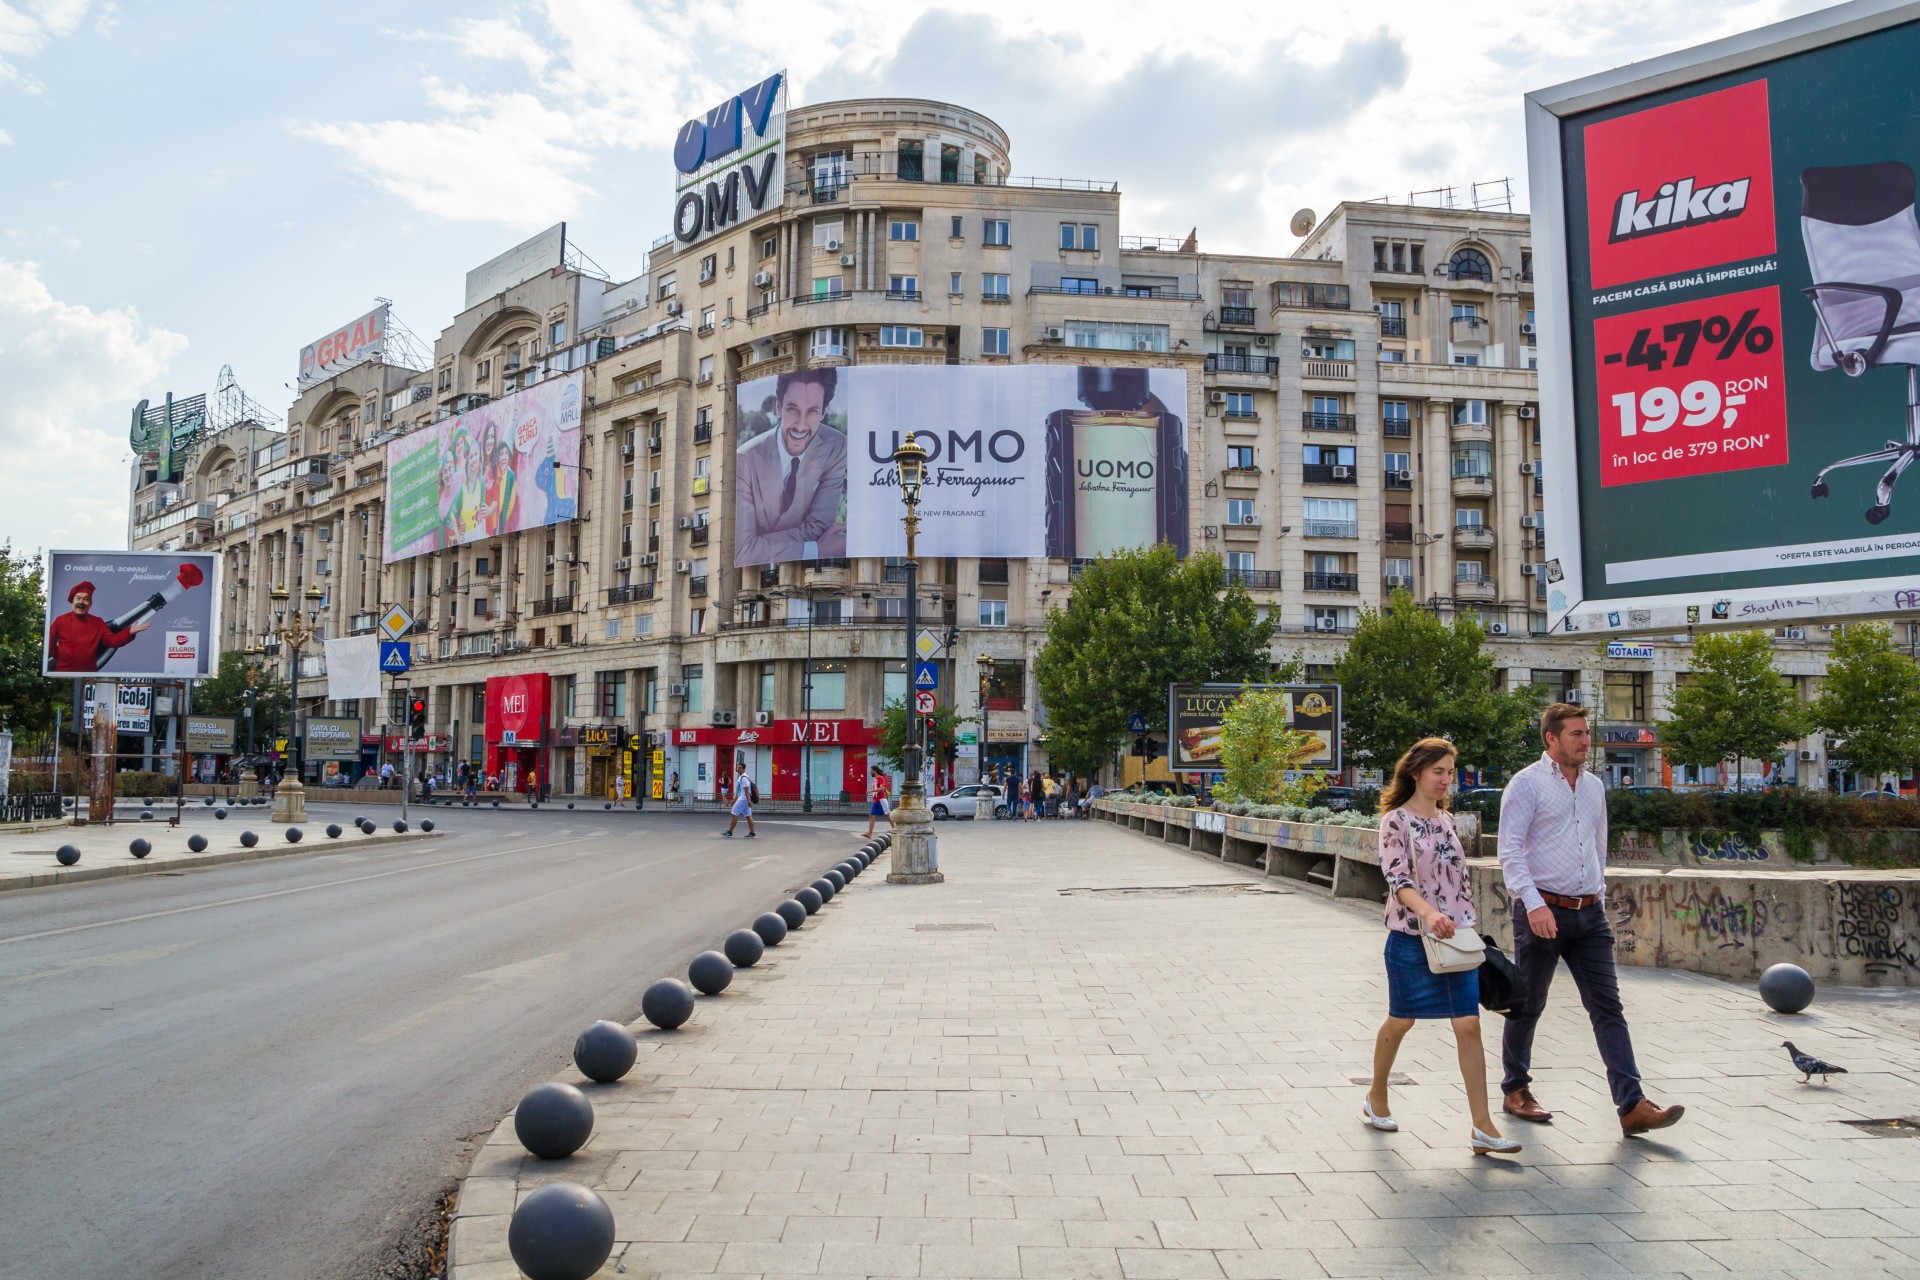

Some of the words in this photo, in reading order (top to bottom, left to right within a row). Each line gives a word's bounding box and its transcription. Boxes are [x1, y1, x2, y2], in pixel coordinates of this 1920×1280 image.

[674, 152, 777, 242] OMV
[1608, 176, 1751, 244] kika
[1592, 290, 1633, 305] FACEM
[1634, 281, 1668, 297] CASĂ
[1669, 274, 1704, 290] BUNĂ
[1706, 260, 1778, 283] ÎMPREUNĂ!
[317, 314, 382, 367] GRAL
[1604, 308, 1774, 372] -47%
[1725, 375, 1768, 394] RON
[560, 407, 579, 425] MALL
[518, 425, 538, 447] ZURLI
[868, 429, 1025, 464] UOMO
[1612, 454, 1628, 467] în
[1633, 451, 1657, 464] loc
[1662, 446, 1684, 460] de
[1688, 441, 1718, 457] 379
[1078, 459, 1154, 479] UOMO
[869, 468, 935, 487] Salve
[936, 467, 1025, 497] Ferragamo
[1079, 481, 1111, 492] Salvatore
[1112, 482, 1155, 498] Ferragamo
[1812, 549, 1832, 558] ESTE
[1833, 544, 1873, 556] VALABILĂ
[1874, 542, 1884, 551] ÎN
[64, 564, 71, 572] O
[73, 564, 93, 572] nouă
[1608, 647, 1653, 657] NOTARIAT
[503, 694, 526, 714] MEI
[1187, 699, 1227, 711] LUCA
[132, 718, 150, 729] mici?
[792, 722, 839, 742] MEI
[309, 731, 351, 739] ASTEPTAREA
[505, 733, 514, 742] M
[586, 729, 609, 742] LUCA
[680, 730, 697, 743] MEI
[1606, 731, 1635, 743] ING
